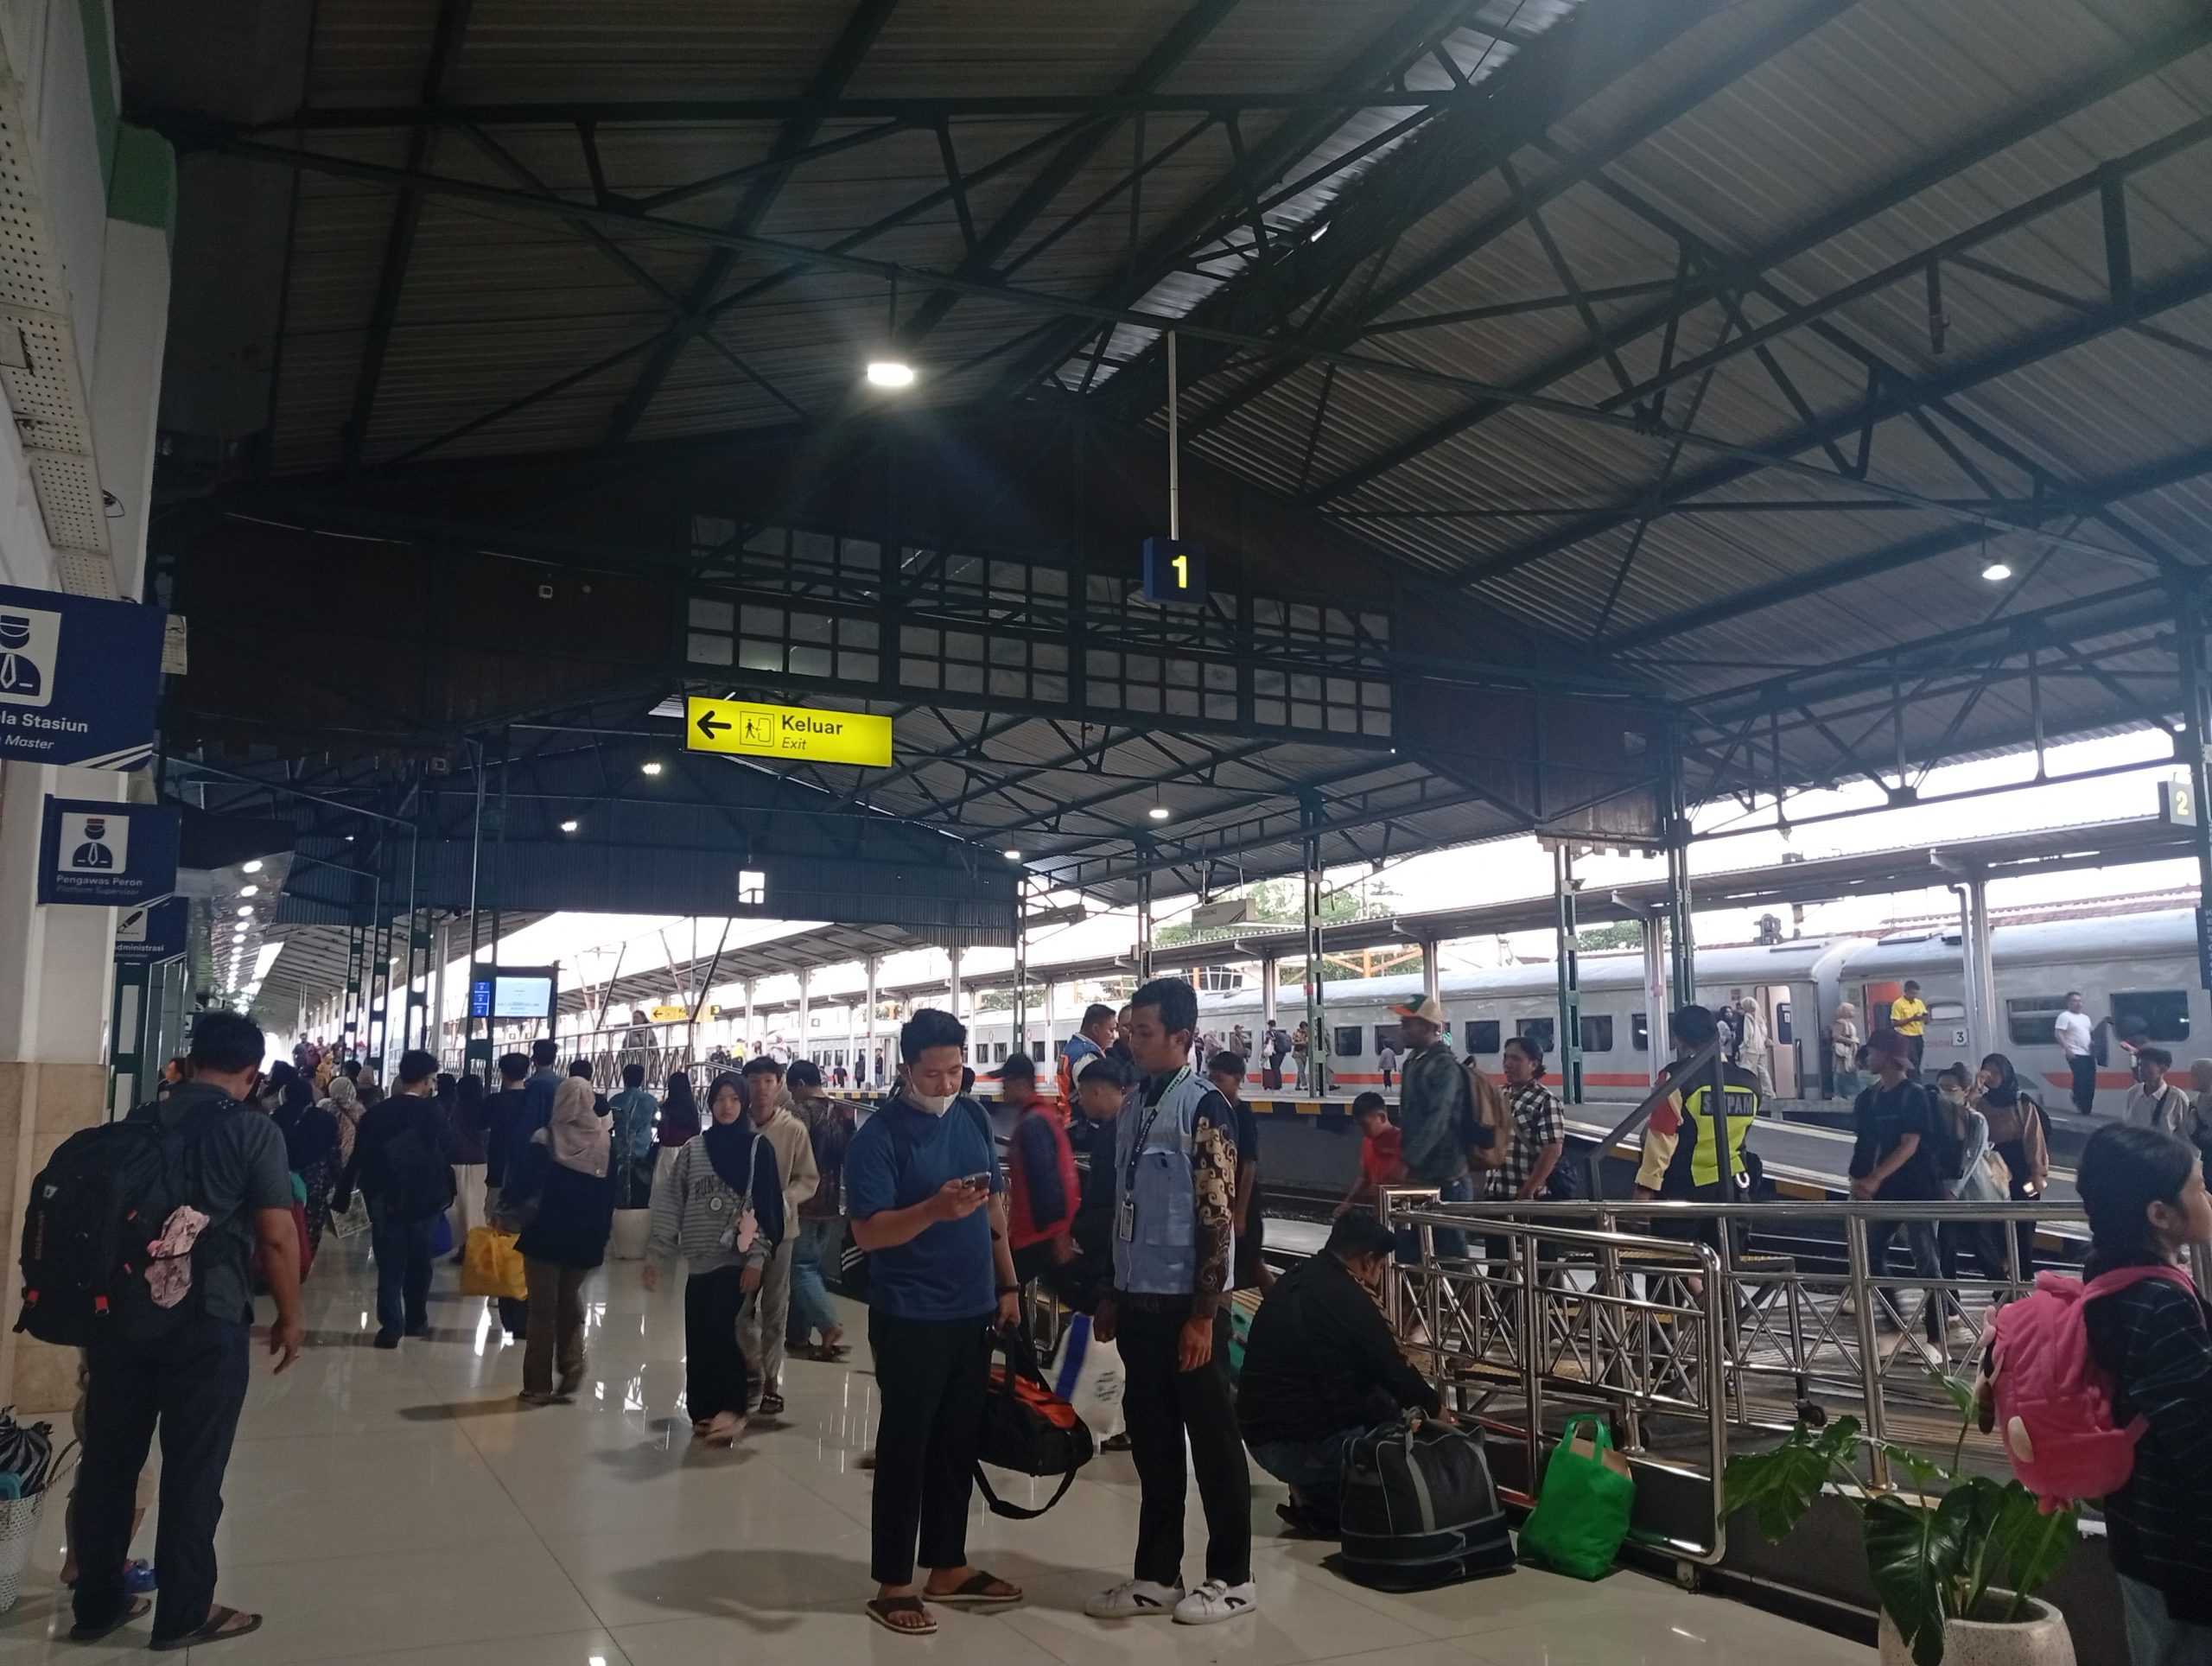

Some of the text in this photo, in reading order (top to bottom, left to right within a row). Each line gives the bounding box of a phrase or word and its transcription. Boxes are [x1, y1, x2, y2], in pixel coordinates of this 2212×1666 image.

[1172, 555, 1187, 588] 1
[22, 713, 88, 733] Stasiun
[781, 714, 843, 735] Keluar
[4, 734, 54, 750] Master
[781, 736, 807, 750] Exit
[2176, 790, 2190, 816] 2
[56, 874, 143, 887] Pengawas Peron
[115, 944, 164, 952] dministrasi
[1956, 1032, 1964, 1043] 3
[1703, 1094, 1753, 1114] SPAM
